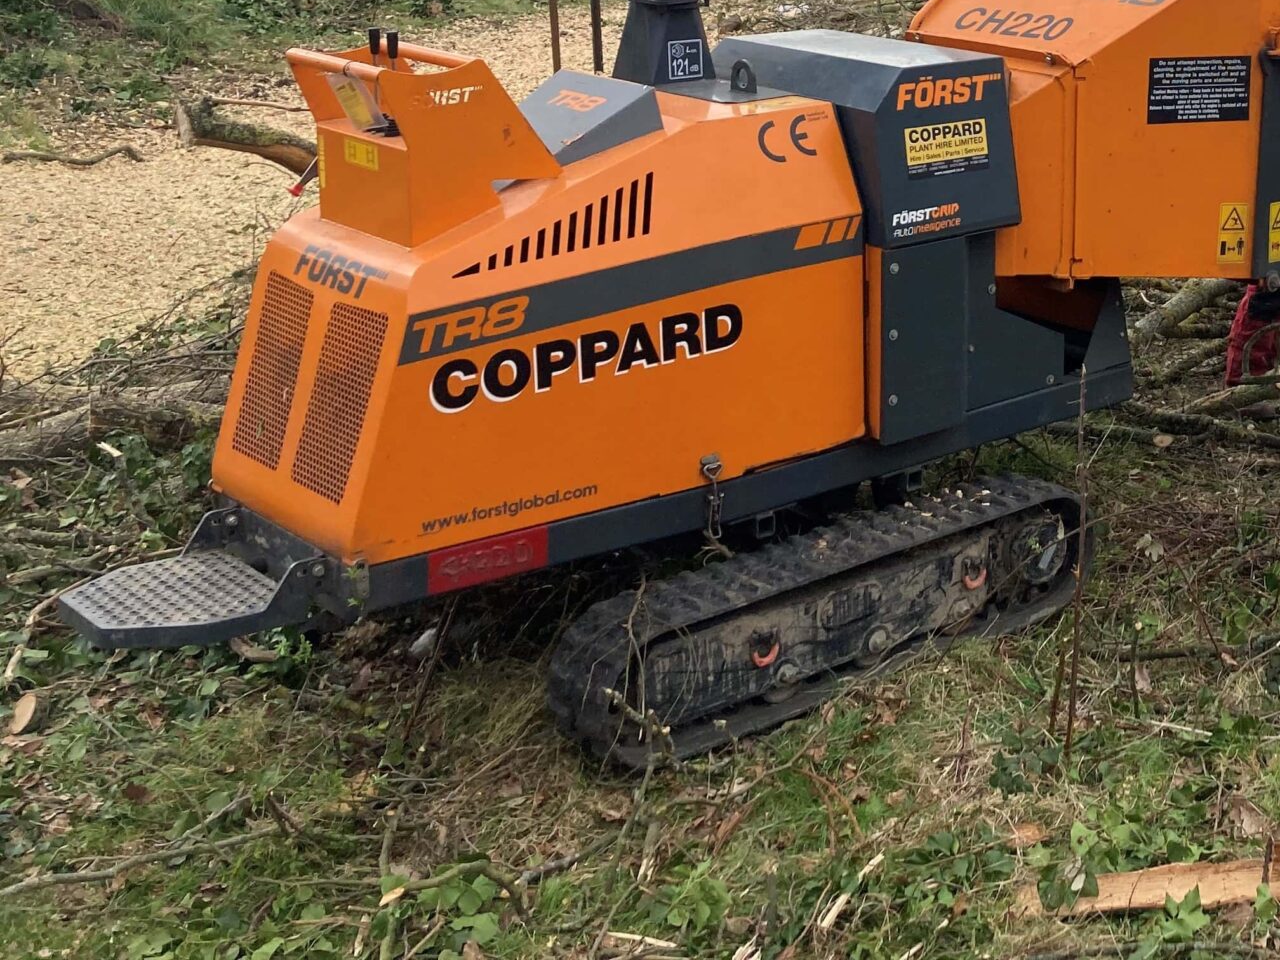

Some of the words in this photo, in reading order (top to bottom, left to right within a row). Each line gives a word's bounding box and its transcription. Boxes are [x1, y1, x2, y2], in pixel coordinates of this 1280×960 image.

[955, 7, 1074, 41] CH220
[672, 58, 689, 75] 121
[547, 89, 608, 112] TR8
[896, 73, 989, 111] FÖRST
[909, 121, 983, 143] COPPARD
[909, 143, 934, 153] PLANT
[935, 141, 953, 149] HIRE
[954, 137, 984, 147] LIMITED
[412, 295, 529, 354] TR8
[429, 303, 743, 413] COPPARD
[422, 484, 598, 533] www.forstglobal.com
